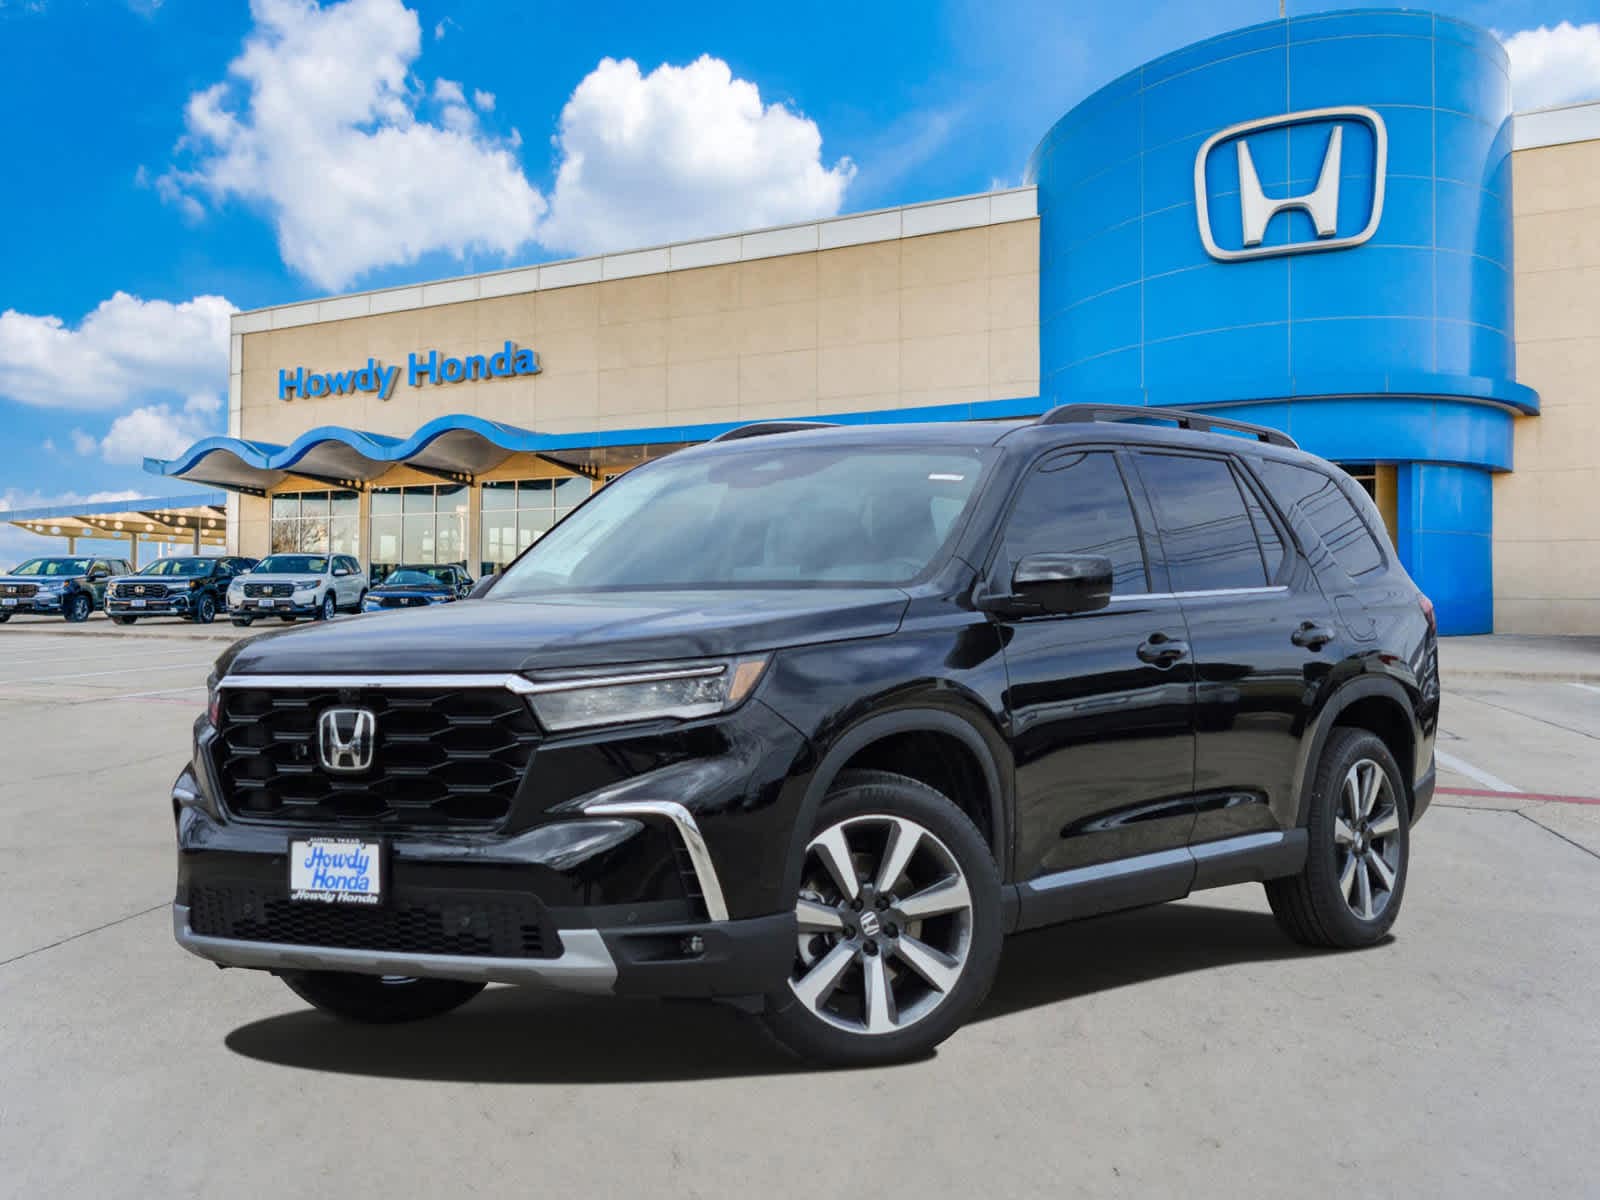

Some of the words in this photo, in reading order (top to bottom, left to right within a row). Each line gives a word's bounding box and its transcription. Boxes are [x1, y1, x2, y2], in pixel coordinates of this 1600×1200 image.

[278, 357, 398, 401] Howdy
[407, 340, 539, 387] Honda
[304, 847, 369, 875] Howdy
[312, 868, 370, 890] Honda
[291, 889, 335, 903] Howdy
[337, 891, 378, 904] Honda
